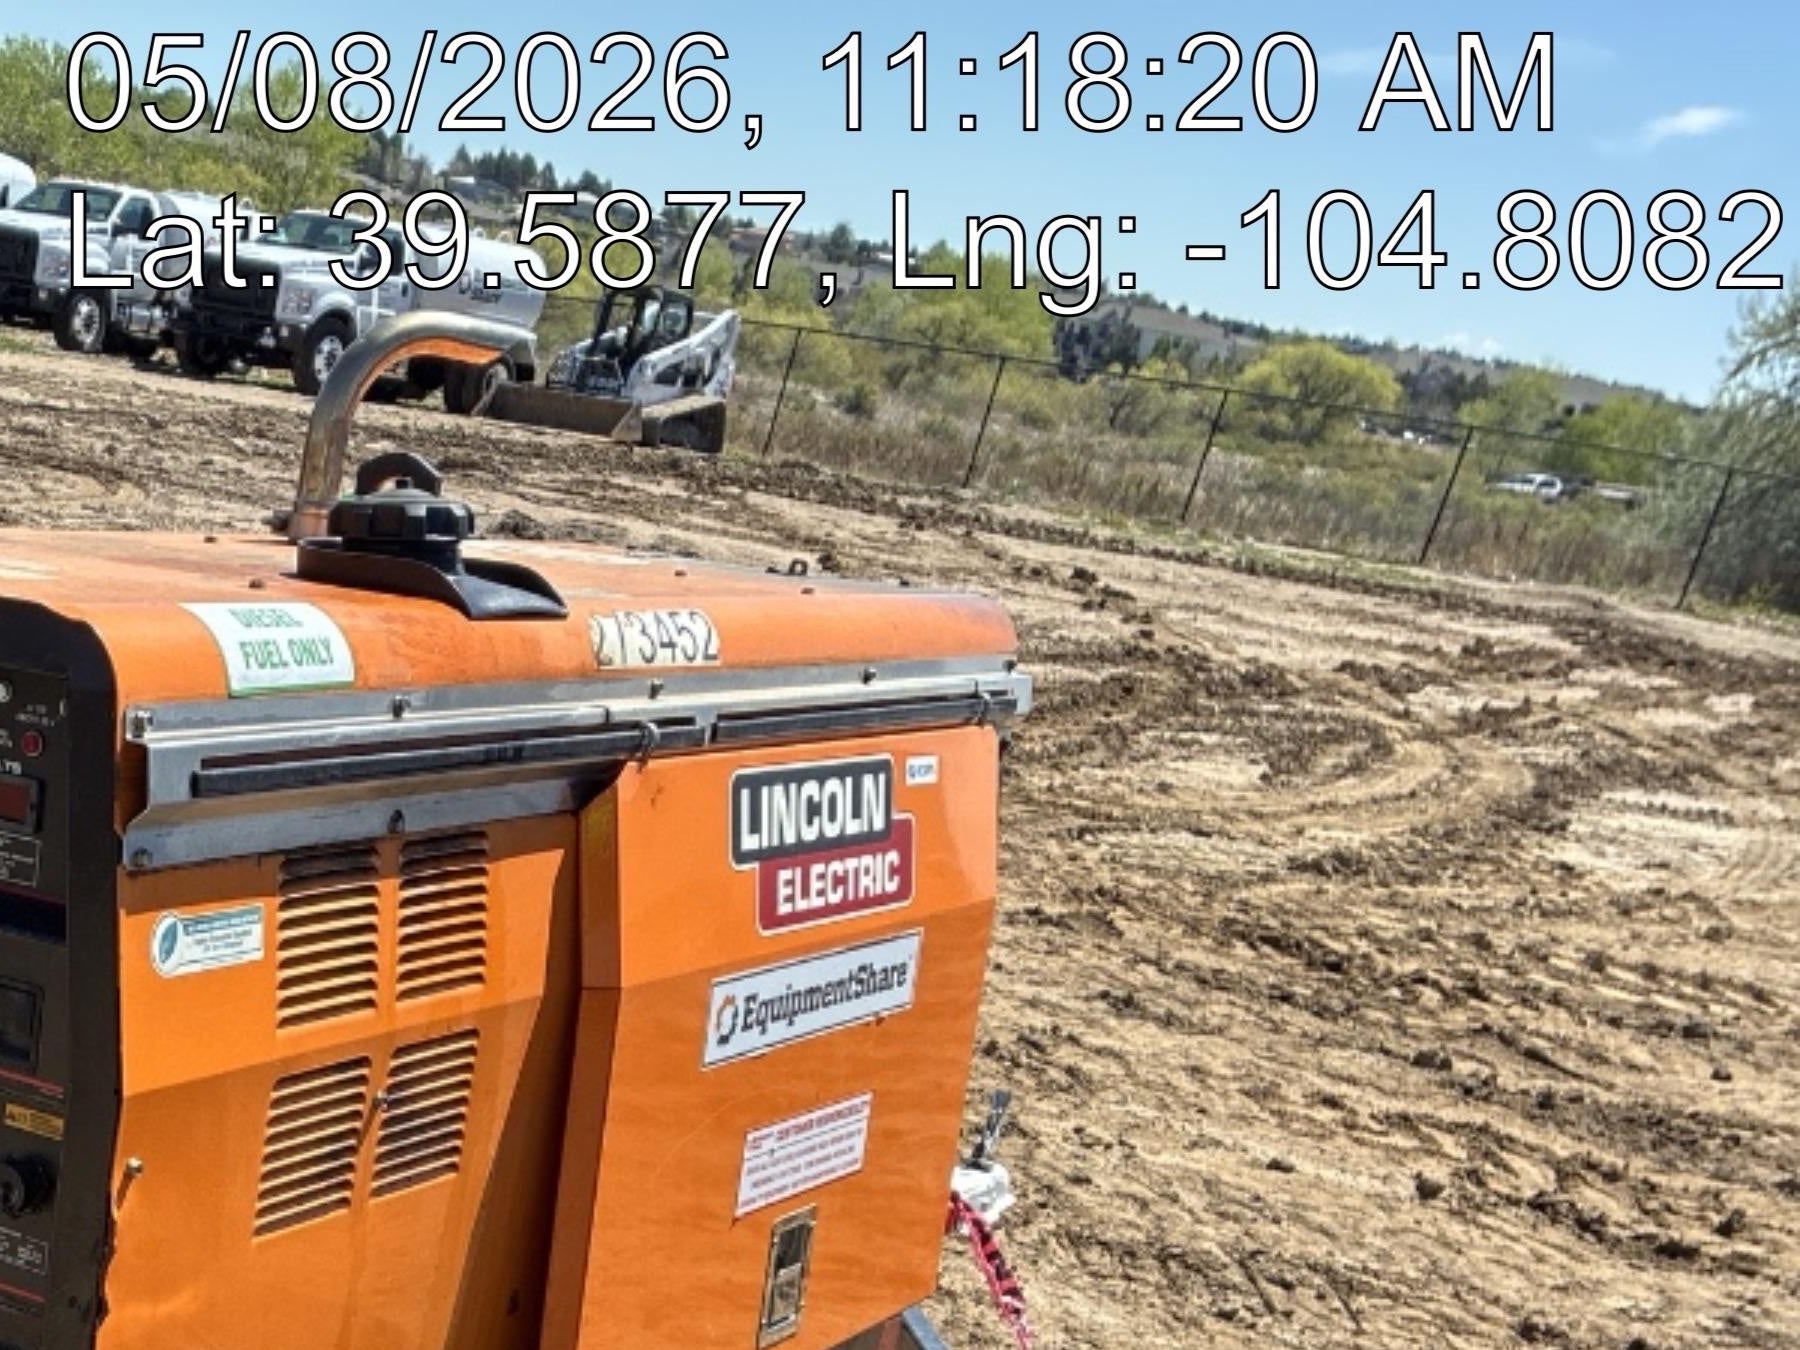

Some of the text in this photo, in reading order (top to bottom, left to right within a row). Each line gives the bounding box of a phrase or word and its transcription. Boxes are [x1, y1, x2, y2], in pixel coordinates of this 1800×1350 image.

[239, 635, 335, 669] FUEL ONLY
[739, 771, 887, 852] LINCOLN
[775, 848, 900, 916] ELECTRIC
[739, 963, 909, 1035] EquipmentShare
